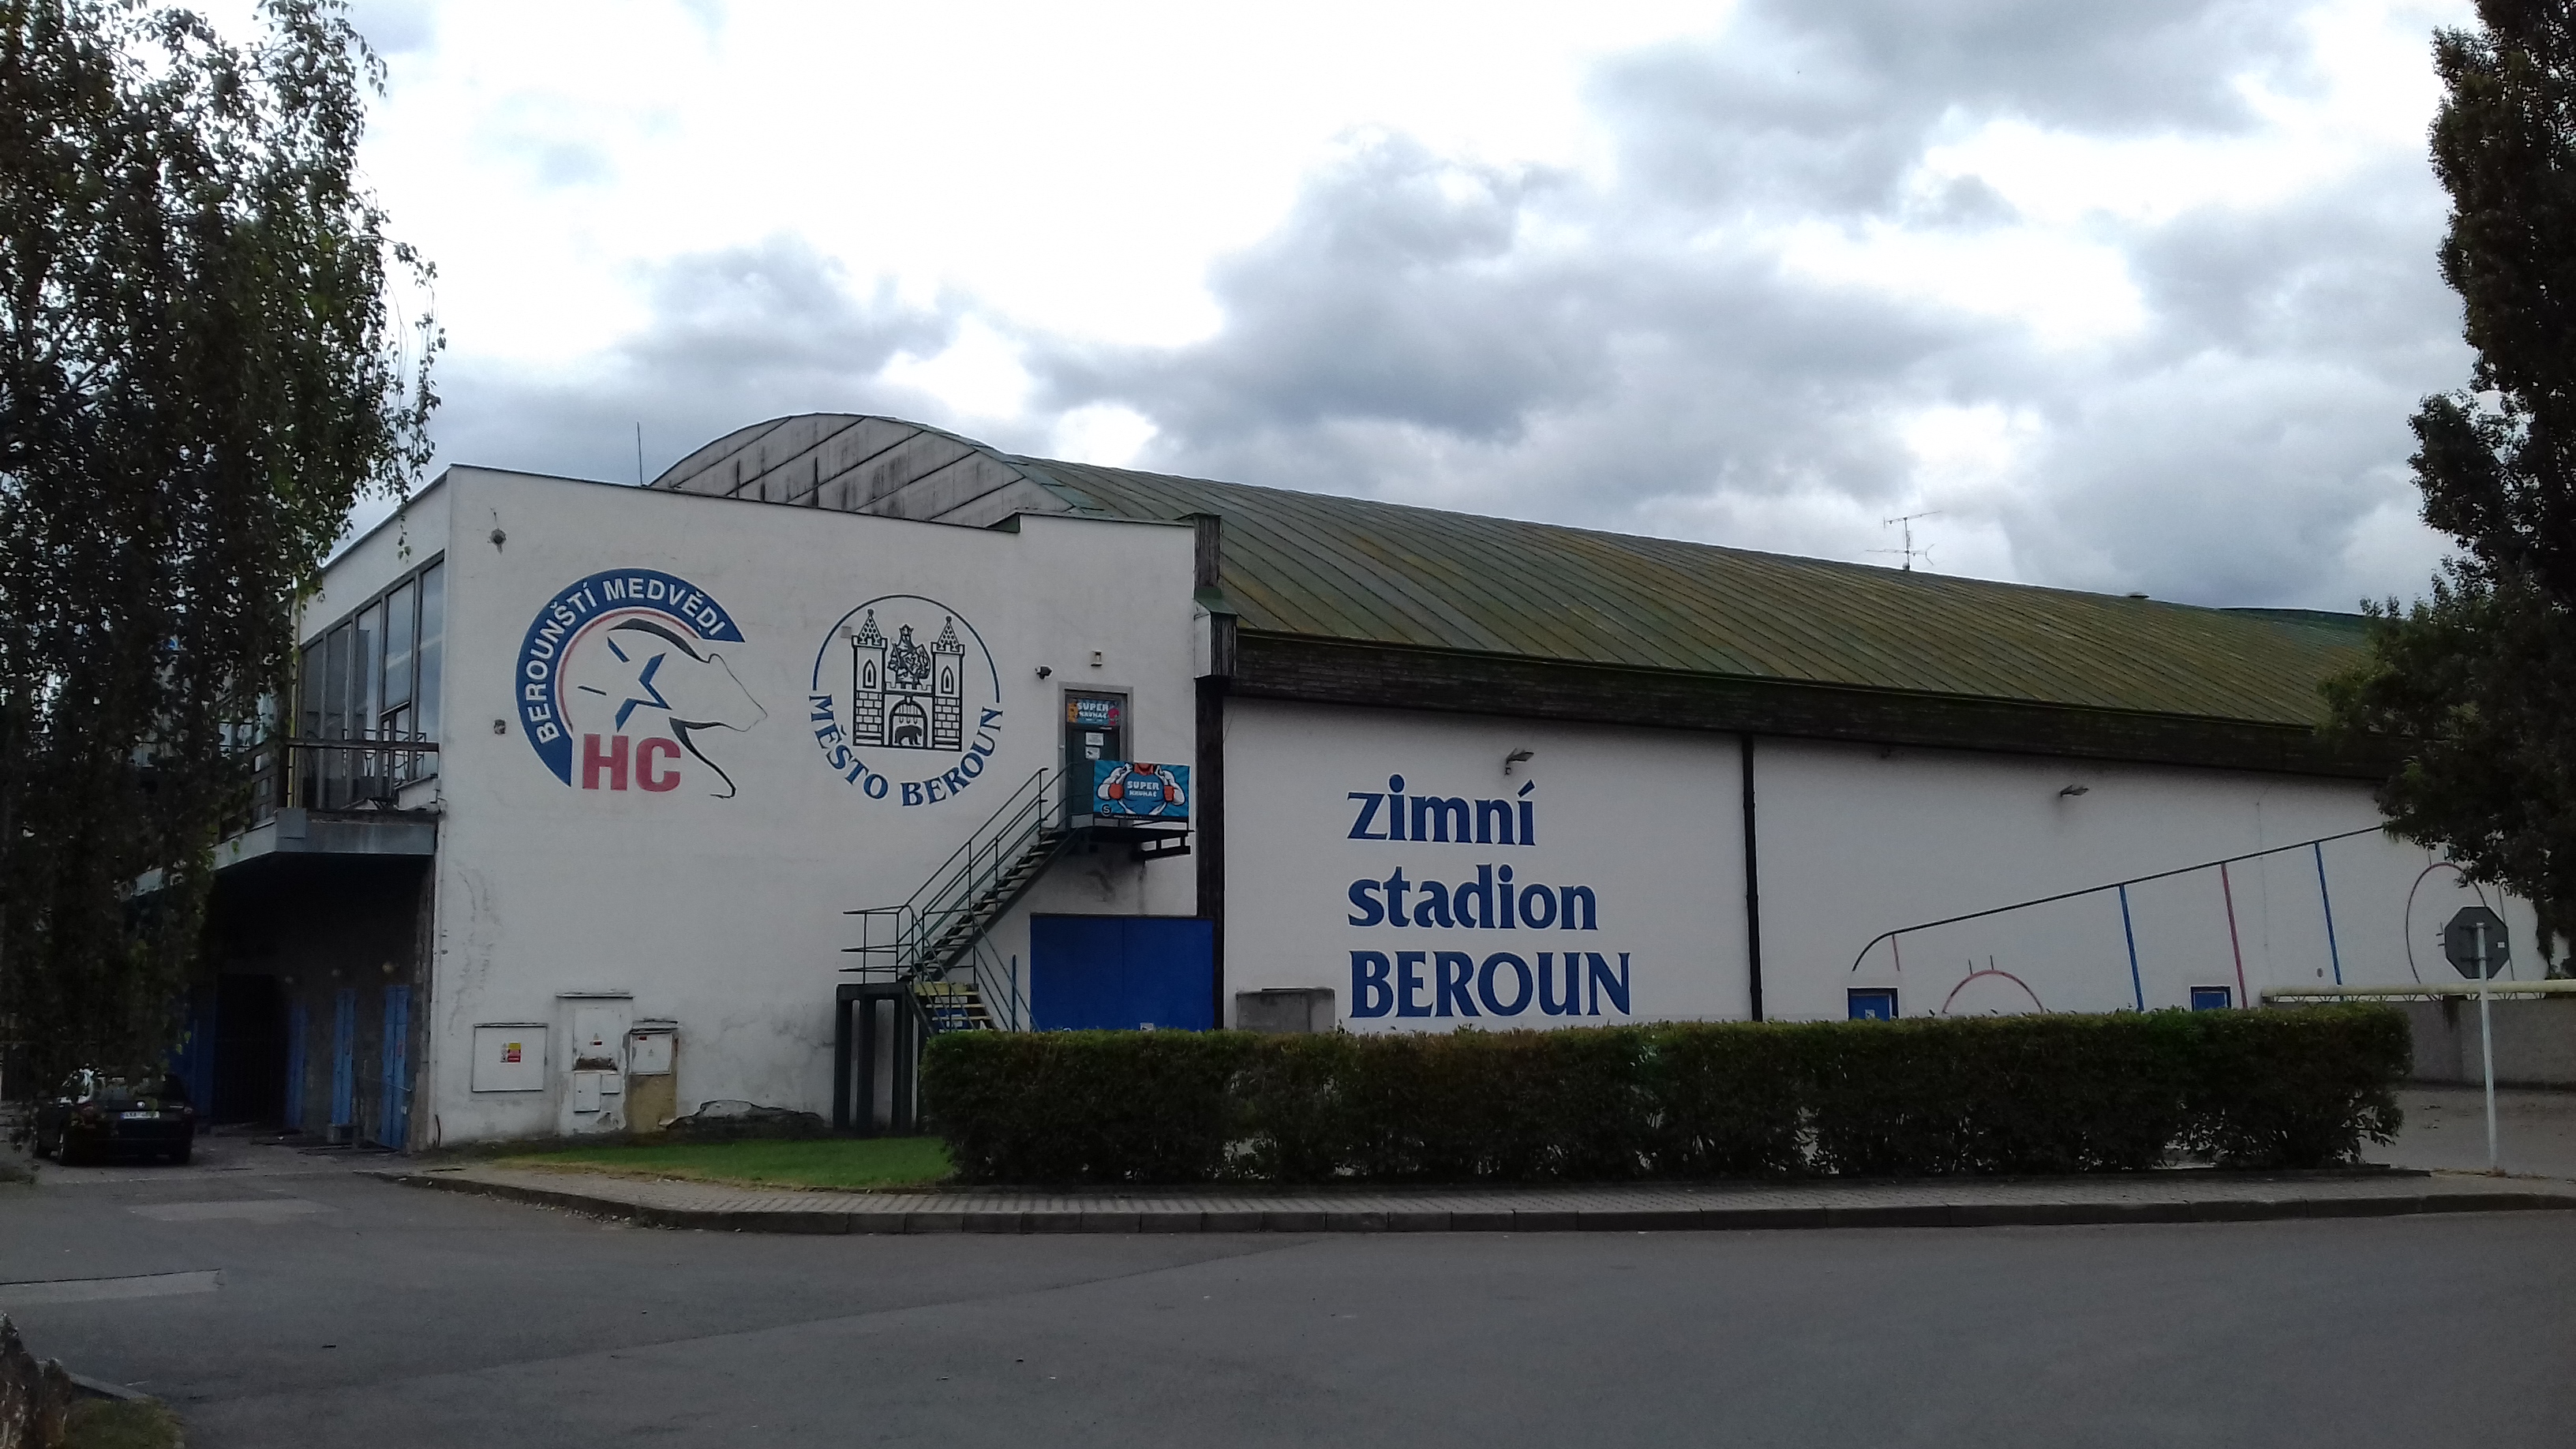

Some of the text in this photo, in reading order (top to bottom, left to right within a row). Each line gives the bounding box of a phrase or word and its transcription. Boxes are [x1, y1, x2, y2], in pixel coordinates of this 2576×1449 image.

[526, 578, 727, 743] BEROUNŠTÍ MEDVĚDI
[1076, 702, 1109, 712] SUPER
[582, 733, 681, 792] HC
[809, 694, 1003, 807] MĚSTO BEROUN
[1127, 781, 1159, 790] SUPER
[1346, 773, 1536, 846] zimní
[1348, 863, 1598, 930] stadion
[1349, 949, 1631, 1018] BEROUN
